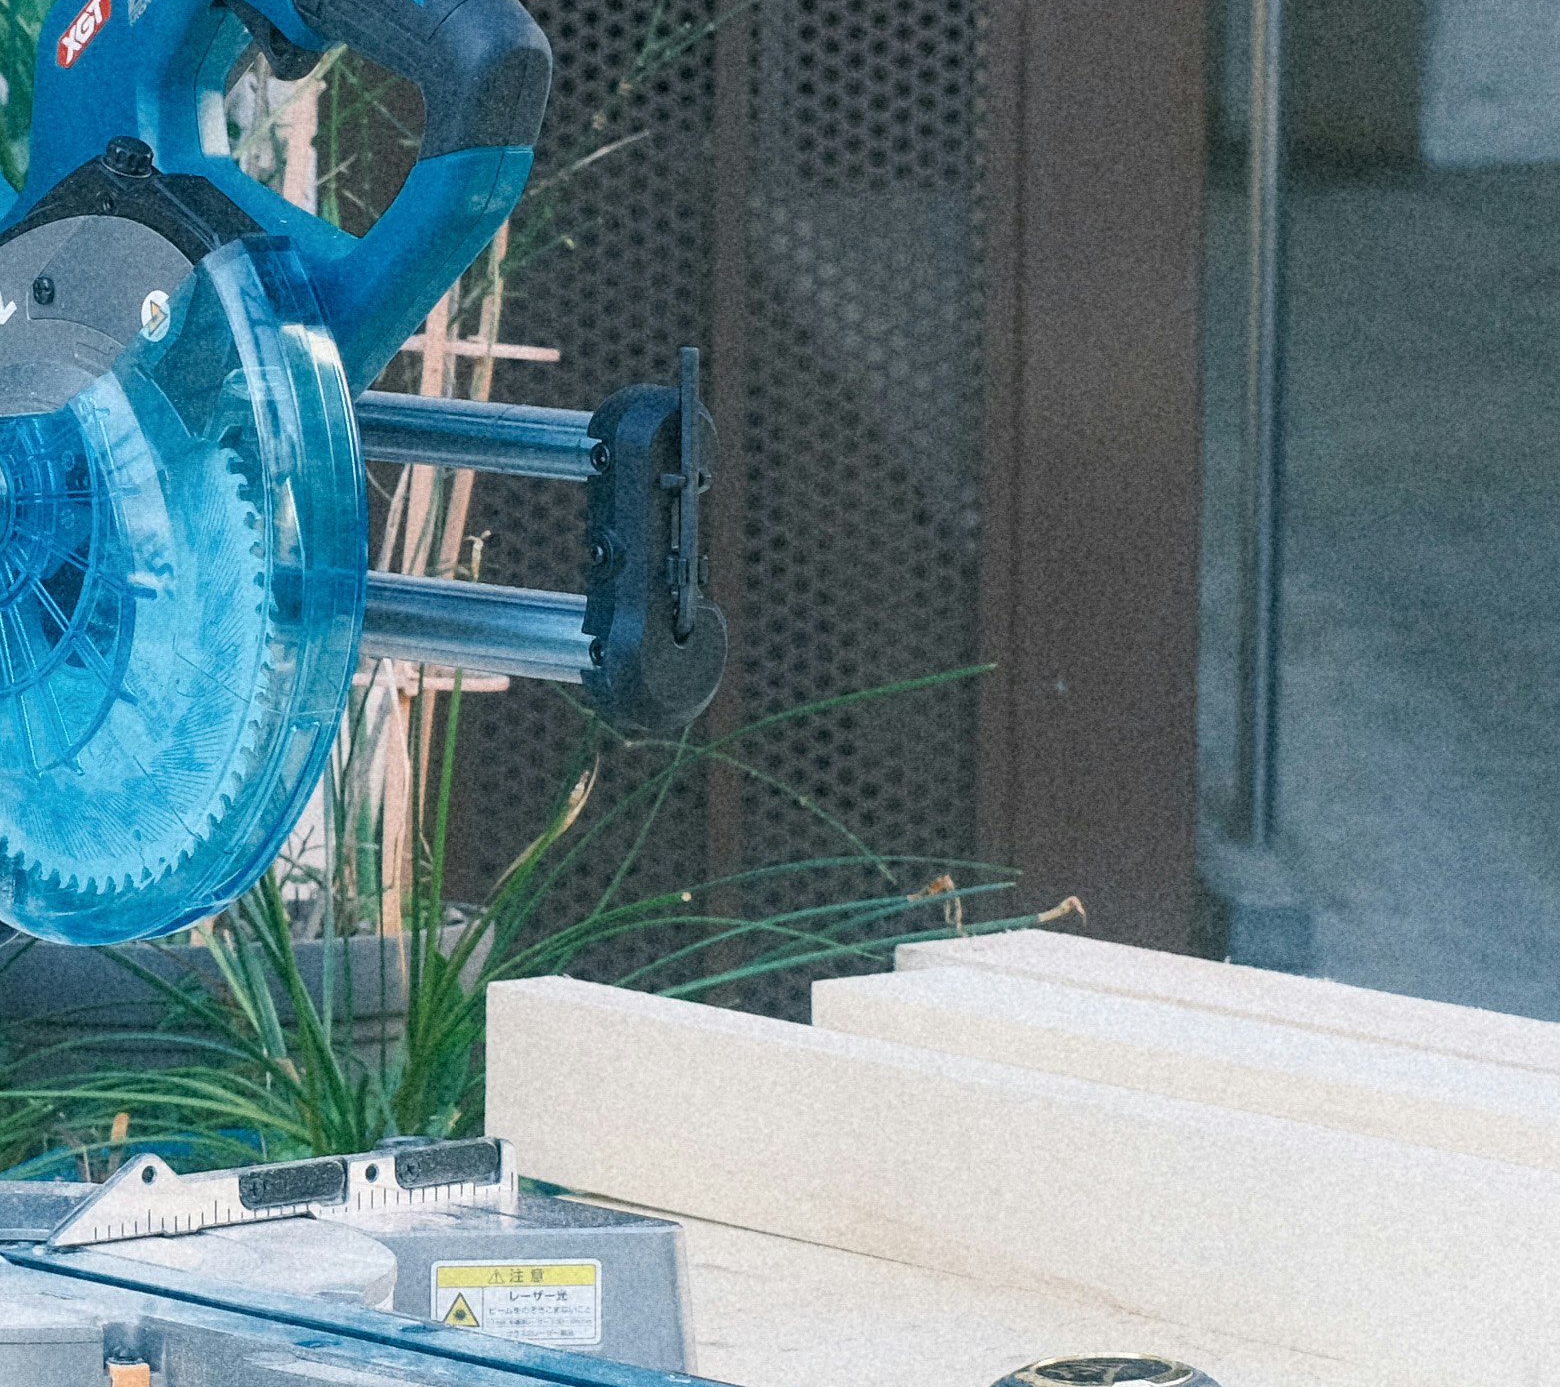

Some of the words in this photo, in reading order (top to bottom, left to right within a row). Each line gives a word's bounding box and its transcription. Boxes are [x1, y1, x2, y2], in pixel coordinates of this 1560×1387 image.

[509, 1268, 544, 1283] 注意
[509, 1290, 568, 1302] レーザー光
